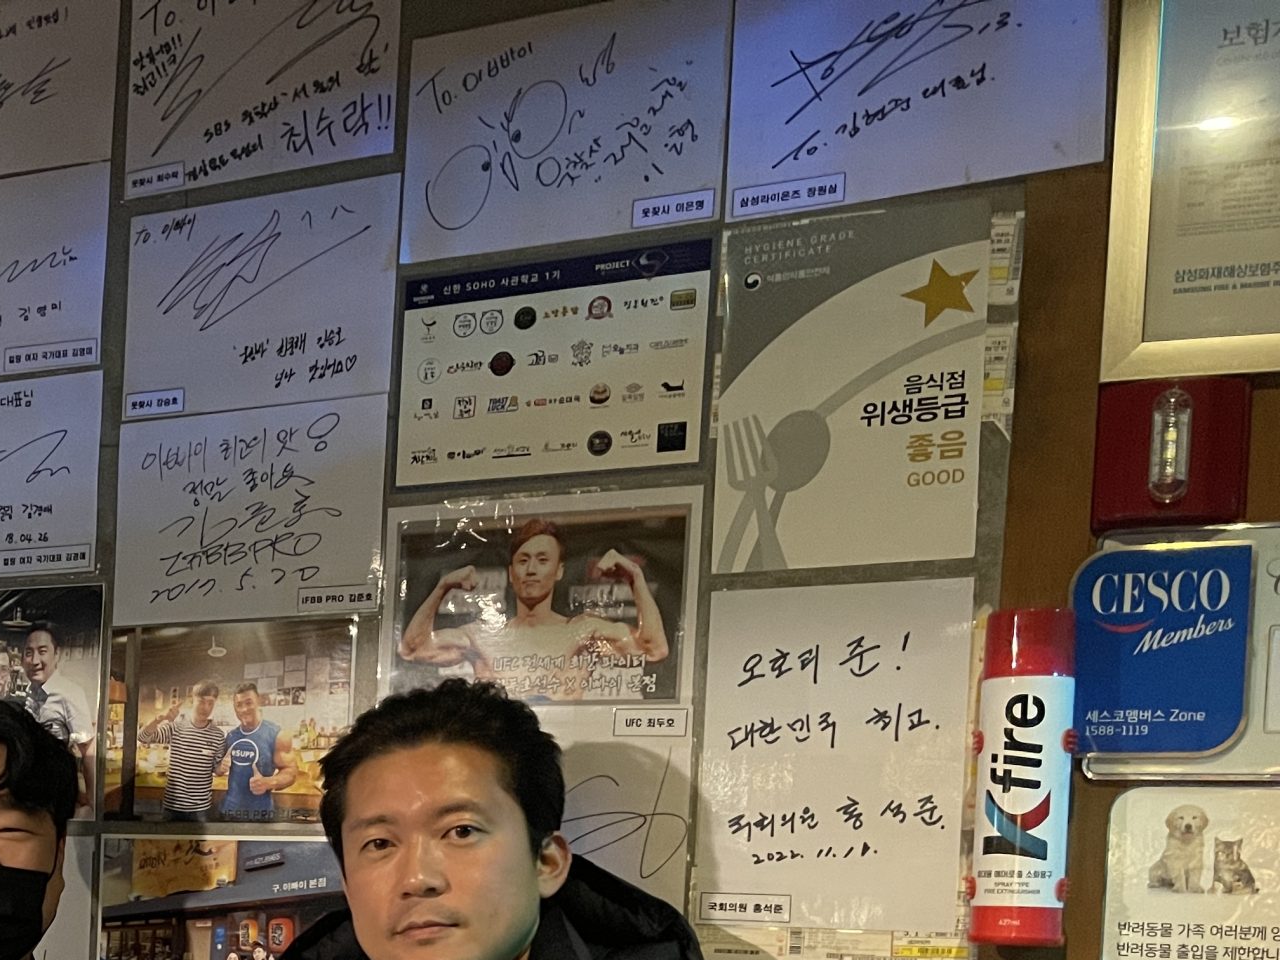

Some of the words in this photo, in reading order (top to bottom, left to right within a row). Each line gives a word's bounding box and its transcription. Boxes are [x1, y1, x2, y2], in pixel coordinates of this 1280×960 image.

[740, 188, 802, 207] 삼성라이온즈
[806, 183, 838, 199] 장원삼
[743, 238, 803, 255] HYGIENE
[810, 230, 856, 249] GRADE
[743, 245, 833, 266] CERTIFICATE
[443, 285, 461, 295] 신한
[466, 279, 496, 291] SOHO
[595, 260, 631, 271] PROJECT
[904, 370, 966, 394] 음식점
[860, 393, 969, 427] 위생등급
[905, 430, 967, 463] 좋음
[907, 469, 966, 487] GOOD
[301, 596, 322, 605] IFBB
[325, 593, 344, 604] PRO
[1092, 569, 1231, 615] CESCO
[1134, 614, 1236, 656] Members
[737, 644, 820, 687] 오호리
[625, 717, 643, 729] UFC
[1085, 709, 1166, 723] 세스코멤버스
[1169, 709, 1206, 723] Zone
[1084, 724, 1149, 737] 1588-1119
[707, 901, 748, 914] 국회의원
[753, 902, 784, 915] 홍석준
[1117, 921, 1173, 937] 반려동물
[1177, 923, 1205, 939] 가족
[1209, 924, 1267, 941] 여러분께
[1116, 942, 1172, 959] 반려동물
[1176, 943, 1218, 960] 출입을
